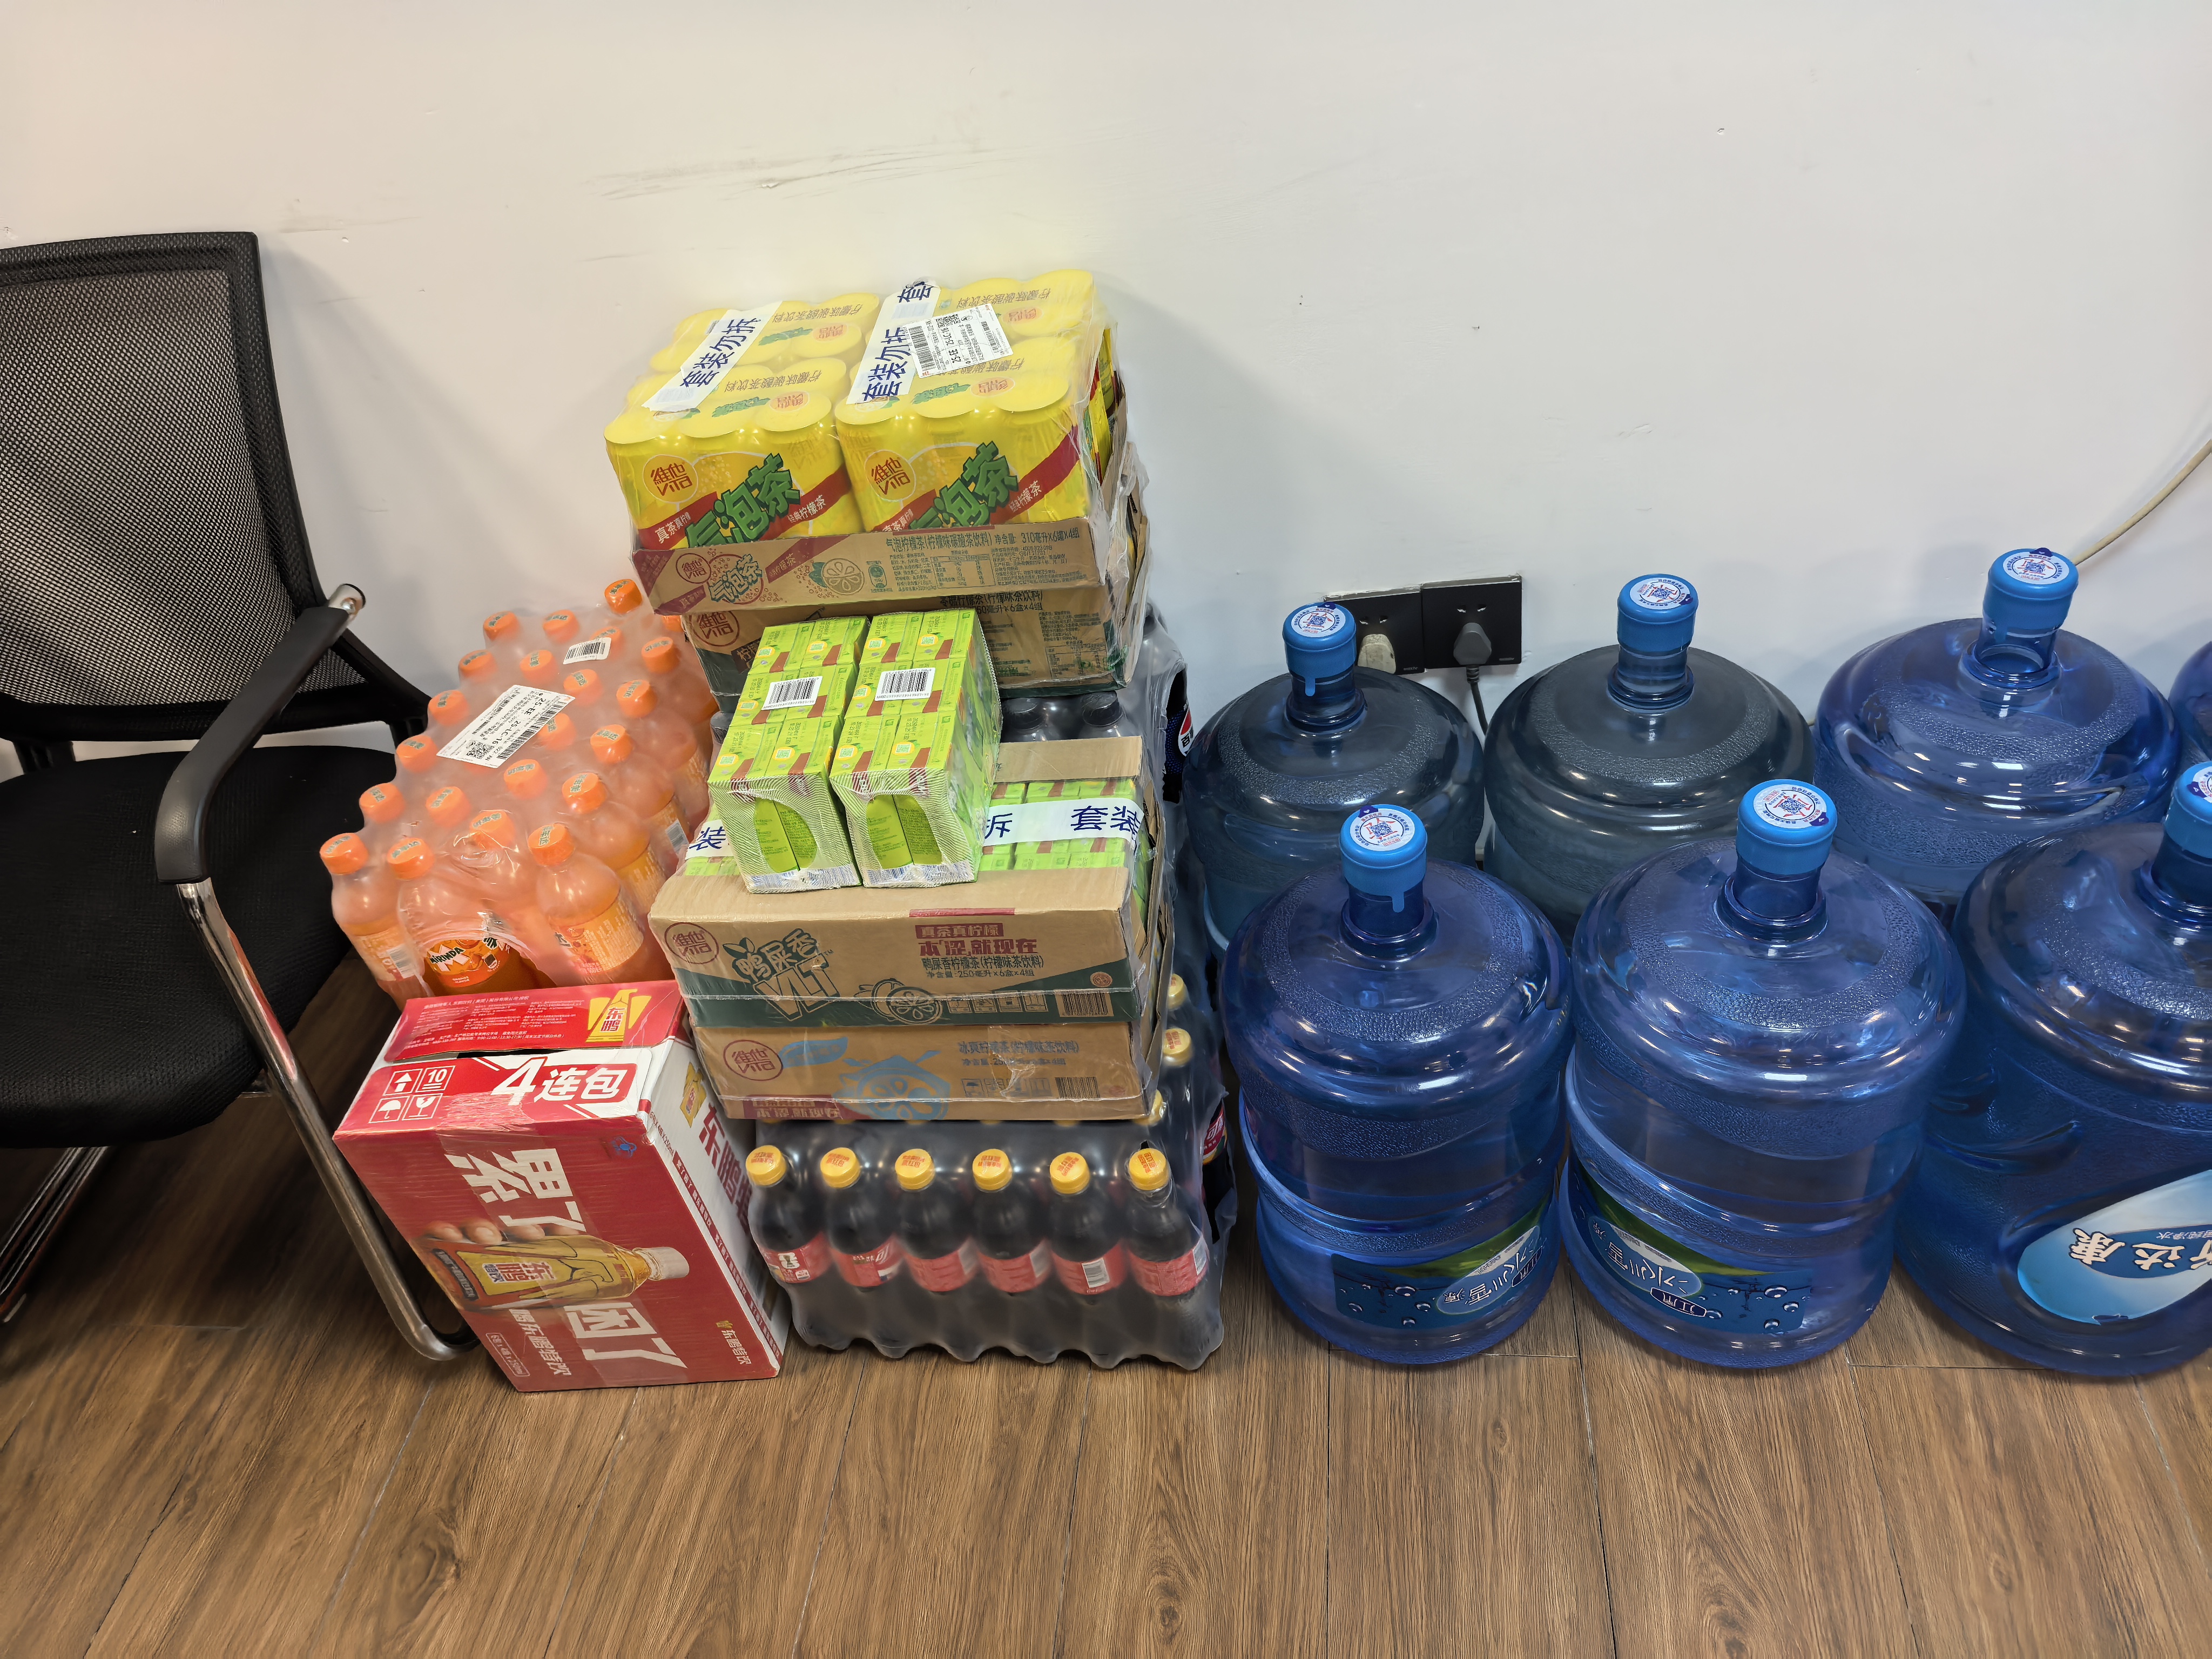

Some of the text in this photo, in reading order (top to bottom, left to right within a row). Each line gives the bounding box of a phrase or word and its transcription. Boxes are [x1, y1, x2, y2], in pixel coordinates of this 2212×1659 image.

[680, 317, 761, 387] 套装勿拆
[689, 827, 726, 850] 装
[1071, 805, 1141, 835] 套装
[427, 1069, 447, 1083] 10
[489, 1057, 624, 1107] 4连包
[444, 1148, 586, 1232] 累了
[563, 1302, 688, 1368] 困了
[509, 1309, 572, 1376] 喝东鹏特饮
[722, 1330, 752, 1365] 东鹏特饮
